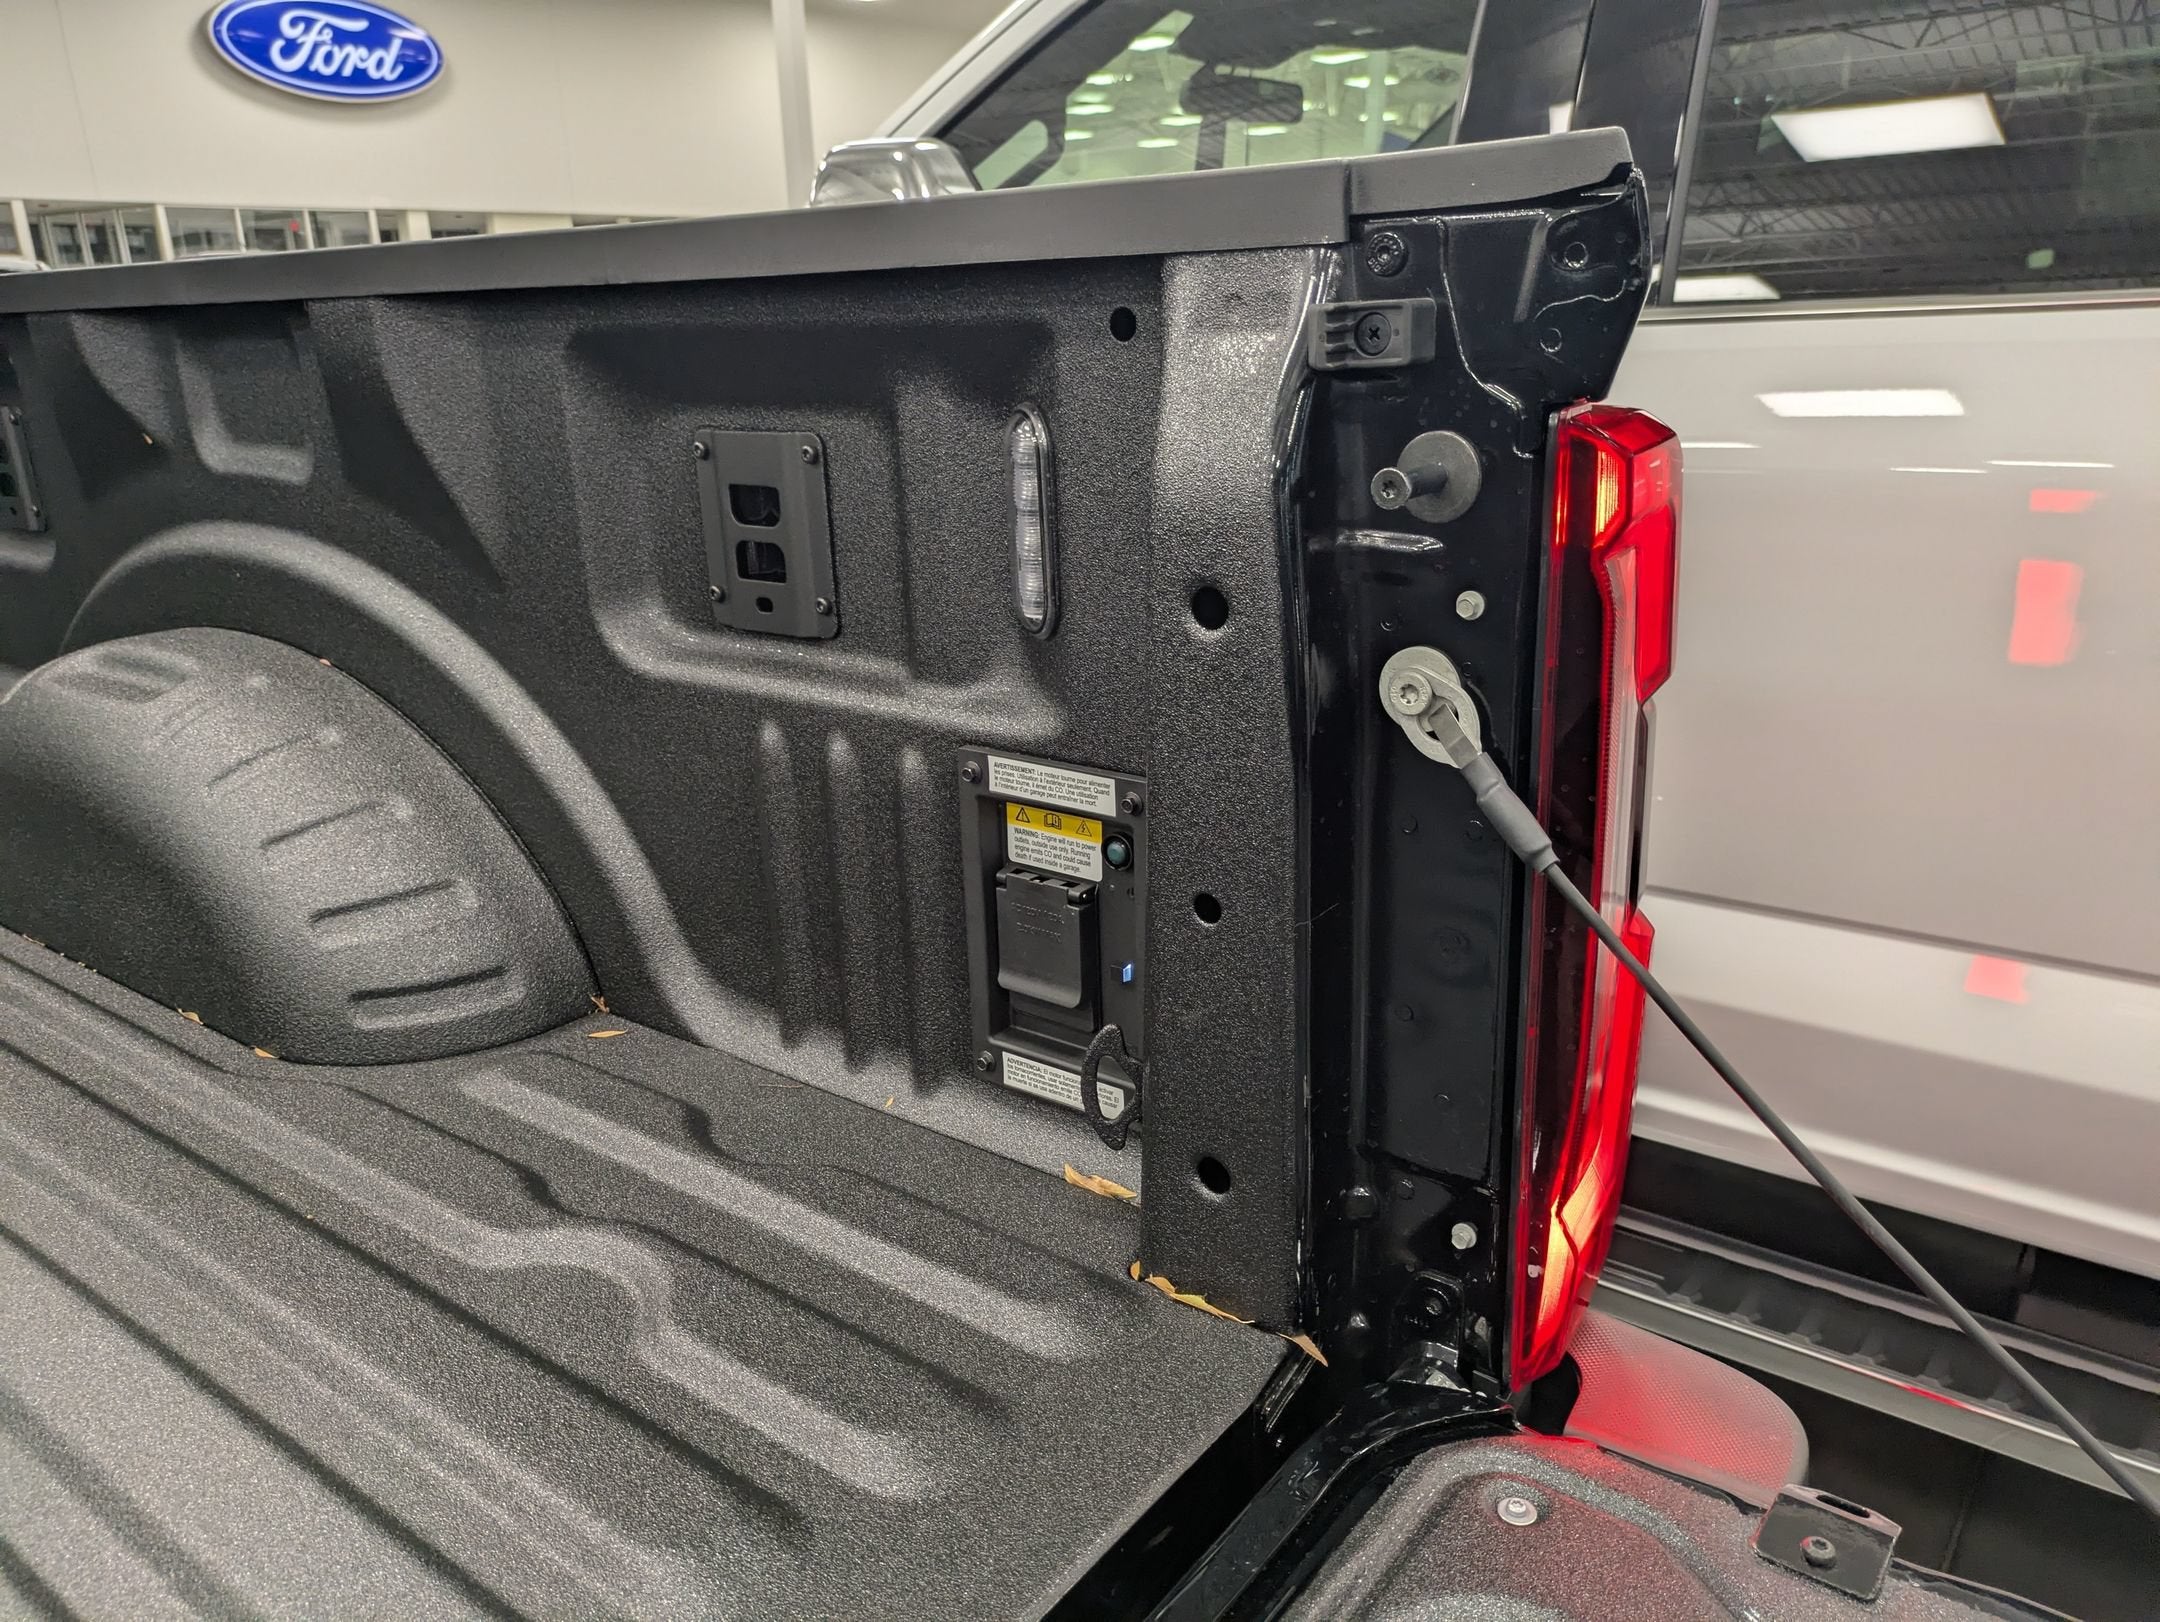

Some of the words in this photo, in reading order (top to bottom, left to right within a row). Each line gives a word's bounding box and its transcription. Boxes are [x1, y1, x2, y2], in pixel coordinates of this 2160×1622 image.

[269, 9, 404, 81] Ford
[994, 762, 1036, 776] AVERTISSEMENT:
[1044, 772, 1059, 780] moteur
[1089, 780, 1110, 789] alimenter
[1030, 789, 1045, 797] garage
[1076, 792, 1098, 800] utilisation
[1094, 787, 1110, 796] Quand
[1014, 827, 1040, 839] WARNING:
[1041, 833, 1057, 843] Engine
[1082, 843, 1096, 851] power
[1015, 844, 1030, 852] engine
[1077, 858, 1091, 867] cause
[1015, 851, 1028, 860] death
[1045, 859, 1058, 867] inside
[1031, 840, 1048, 849] outside
[1071, 848, 1090, 860] Running
[1013, 1076, 1027, 1085] muerte
[1049, 1088, 1065, 1098] adentro
[1102, 1100, 1118, 1108] causar
